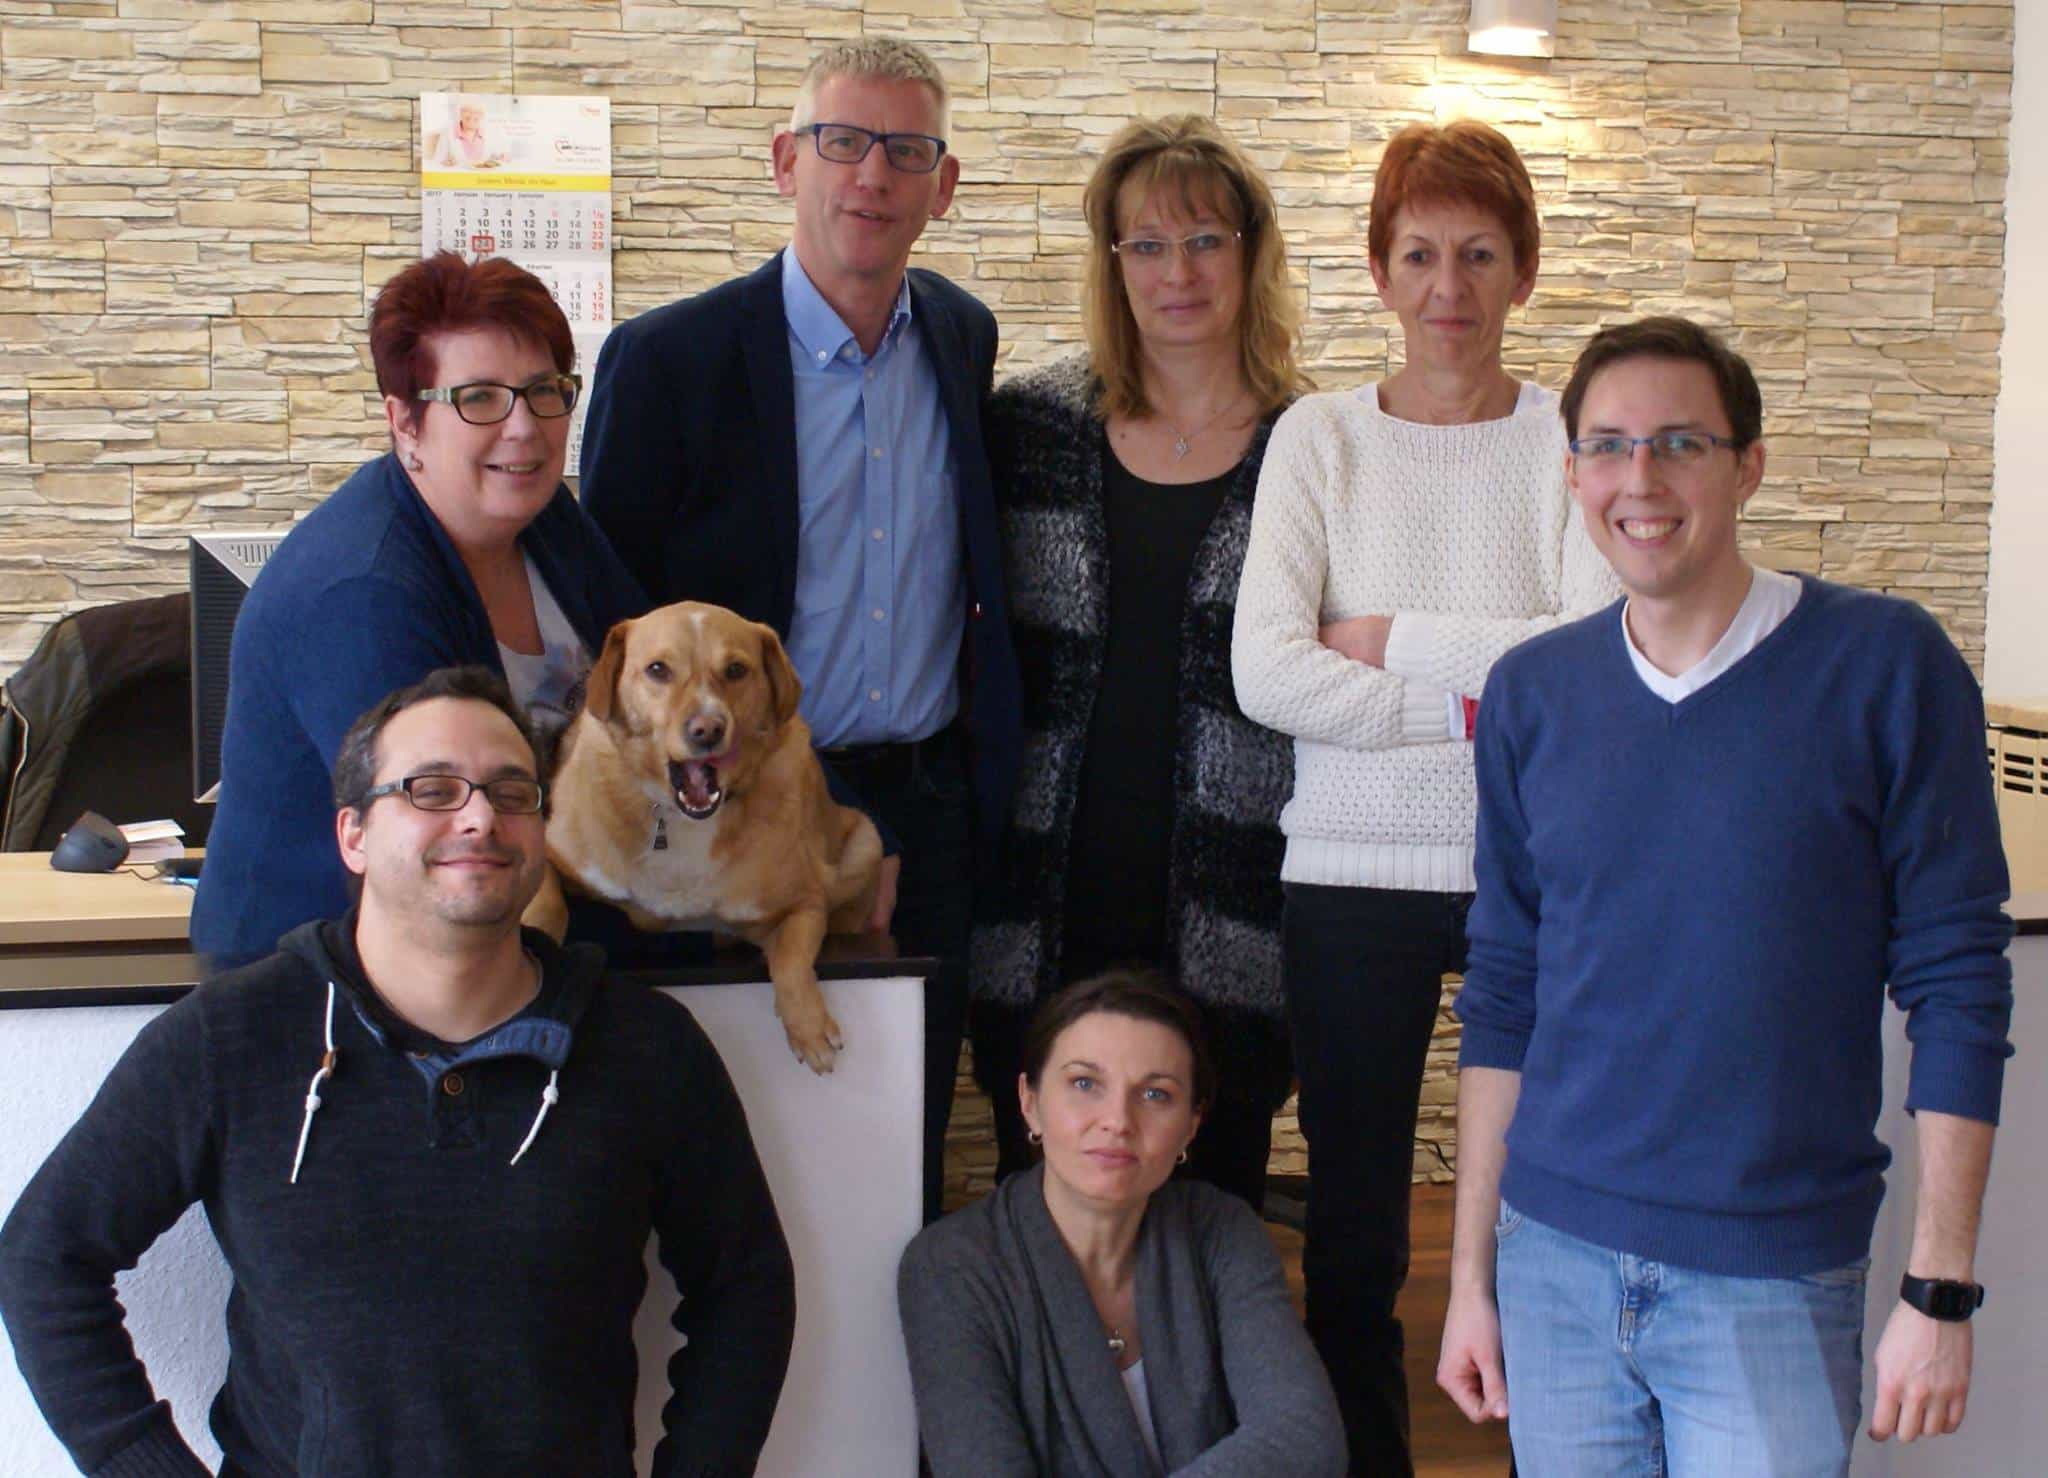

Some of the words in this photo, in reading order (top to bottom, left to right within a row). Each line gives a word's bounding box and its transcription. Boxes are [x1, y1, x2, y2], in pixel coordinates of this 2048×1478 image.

[459, 208, 466, 217] 2
[483, 208, 489, 217] 3
[505, 208, 512, 217] 4
[529, 209, 535, 218] 5
[459, 218, 466, 227] 9
[477, 219, 490, 227] 10
[500, 219, 512, 228] 11
[523, 219, 535, 228] 12
[546, 219, 559, 228] 13
[569, 220, 581, 229] 14
[592, 221, 604, 229] 15
[454, 229, 466, 237] 16
[500, 230, 512, 238] 18
[523, 230, 536, 239] 19
[546, 230, 559, 239] 20
[569, 231, 581, 239] 21
[592, 231, 604, 240] 22
[454, 240, 466, 248] 23
[499, 240, 513, 249] 25
[522, 240, 536, 249] 26
[545, 241, 559, 249] 27
[568, 241, 582, 250] 28
[592, 241, 604, 250] 29
[552, 281, 559, 290] 3
[575, 281, 581, 290] 4
[598, 281, 604, 290] 5
[570, 292, 581, 300] 11
[593, 292, 604, 301] 12
[570, 302, 581, 311] 18
[592, 303, 604, 312] 19
[568, 312, 582, 321] 25
[592, 312, 604, 321] 26
